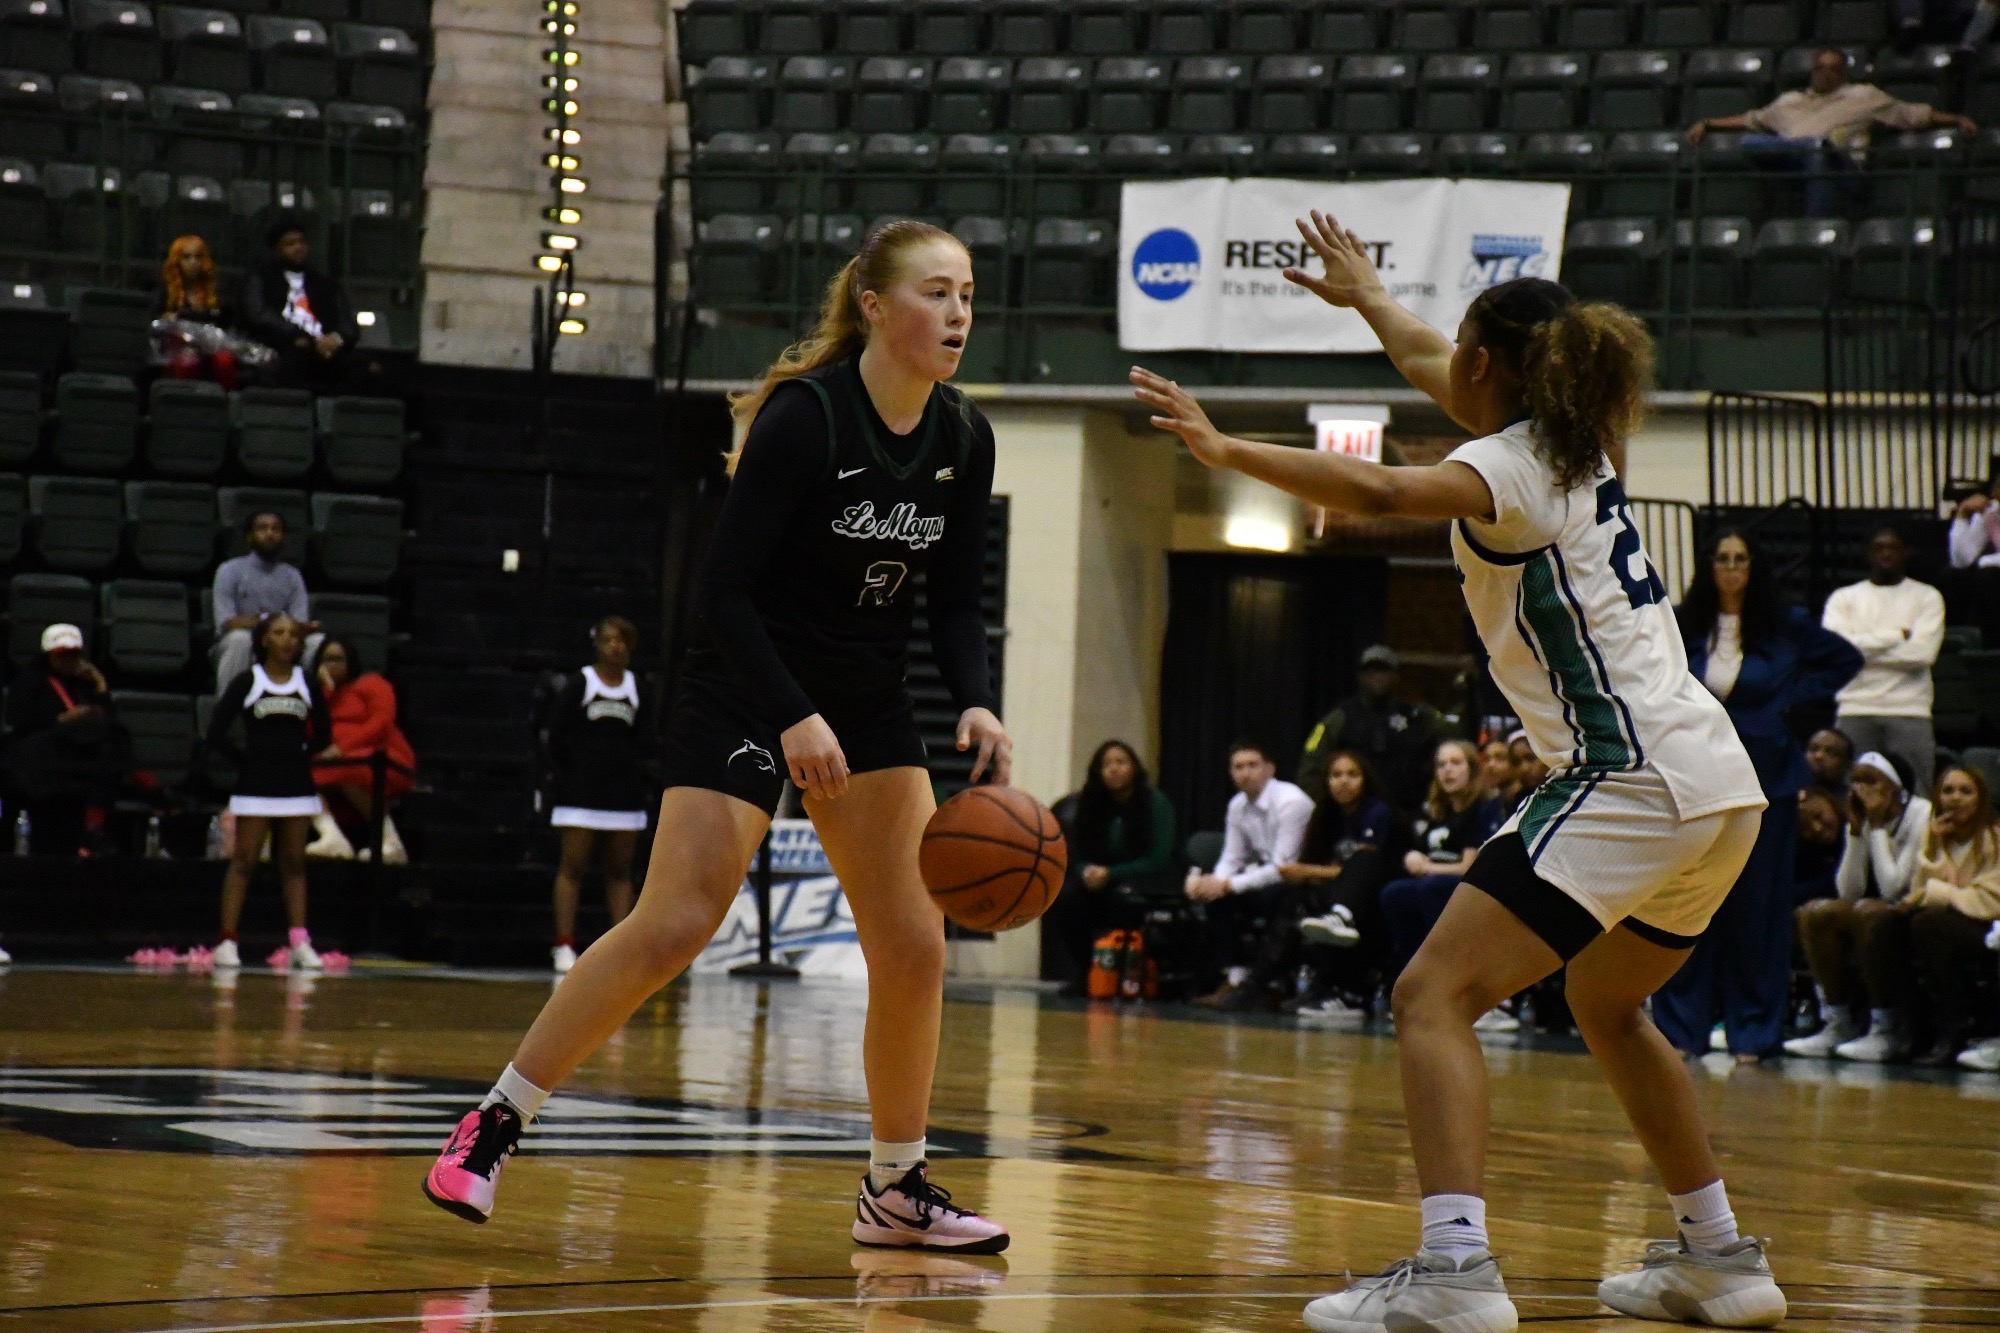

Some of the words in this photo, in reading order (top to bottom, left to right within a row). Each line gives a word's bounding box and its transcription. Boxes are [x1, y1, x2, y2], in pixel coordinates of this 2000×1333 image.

[1225, 240, 1396, 269] RESPT.
[1136, 262, 1200, 285] NCAA
[1250, 280, 1278, 297] the
[856, 560, 908, 607] 2
